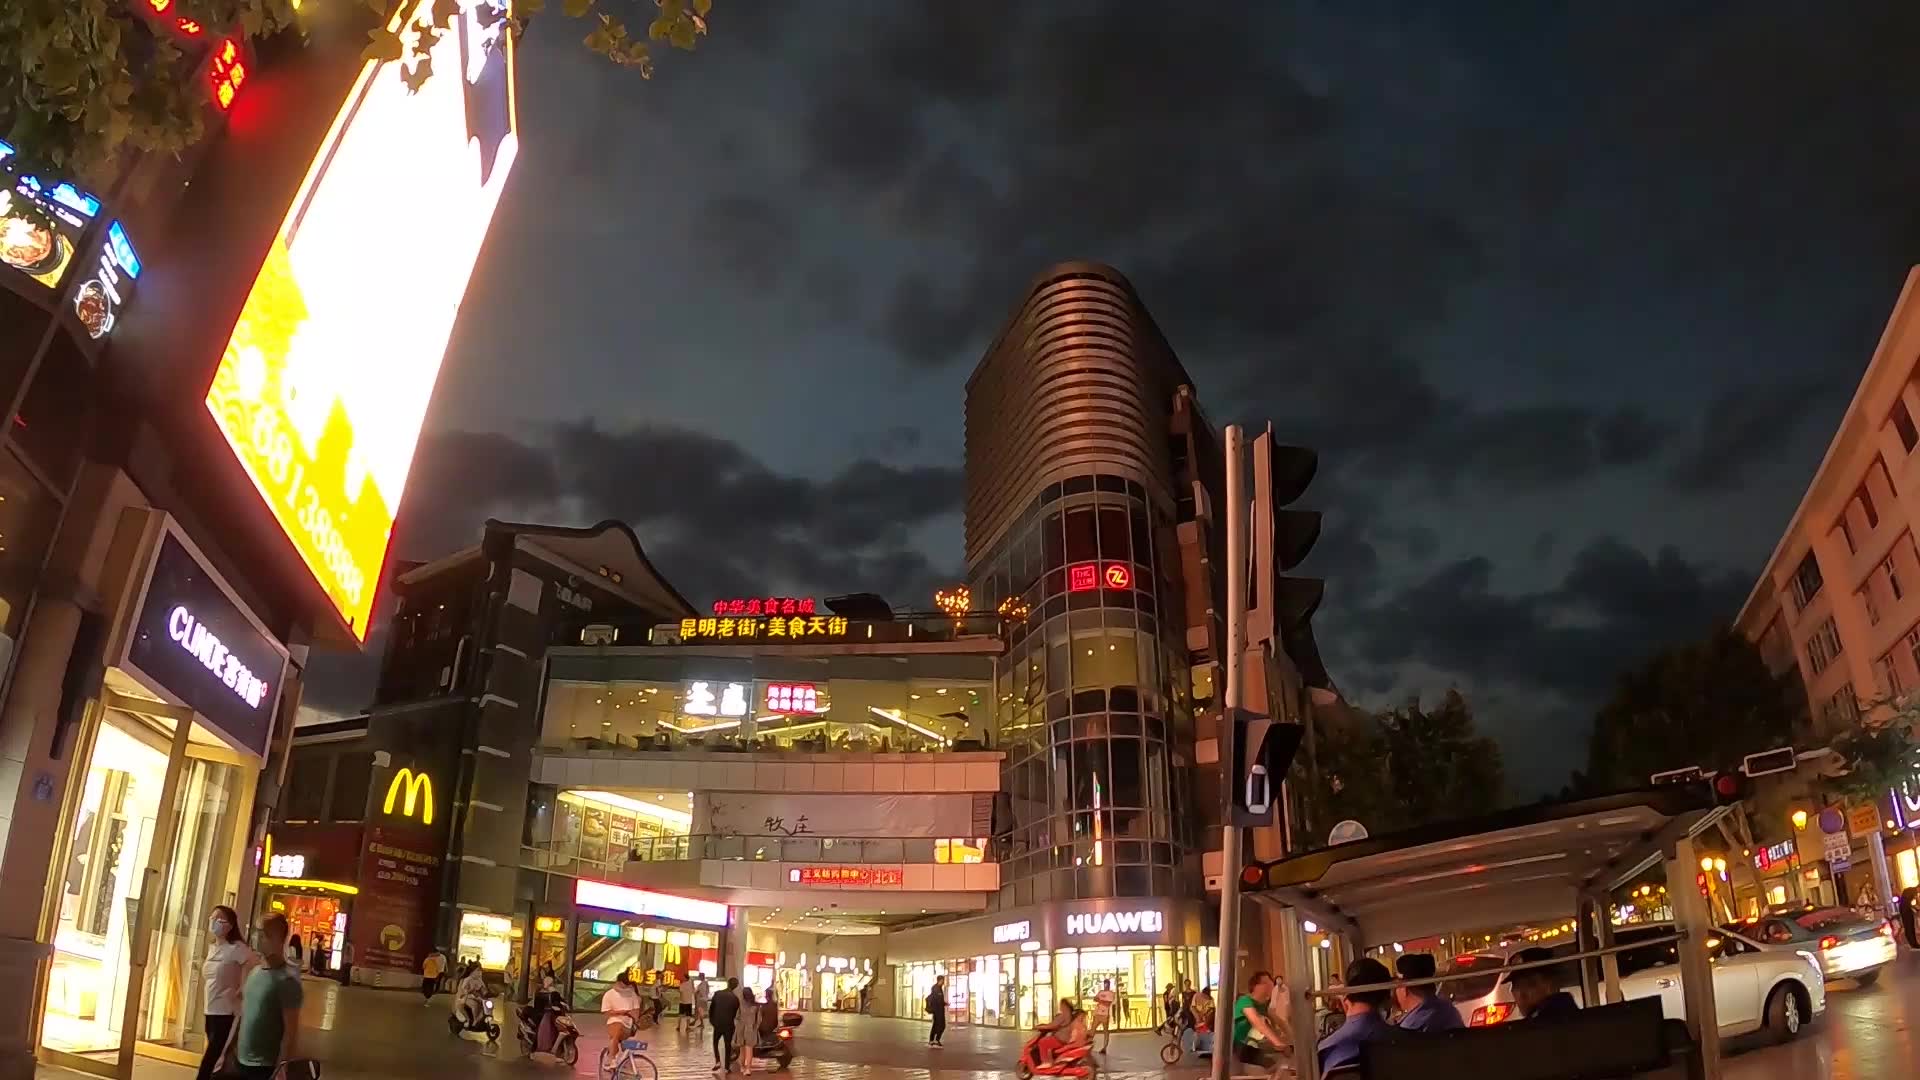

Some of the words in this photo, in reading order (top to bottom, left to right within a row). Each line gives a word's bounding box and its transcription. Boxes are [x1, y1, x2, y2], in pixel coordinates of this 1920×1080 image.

[713, 598, 816, 615] 中华美食名城
[1067, 910, 1163, 935] HUAWEI
